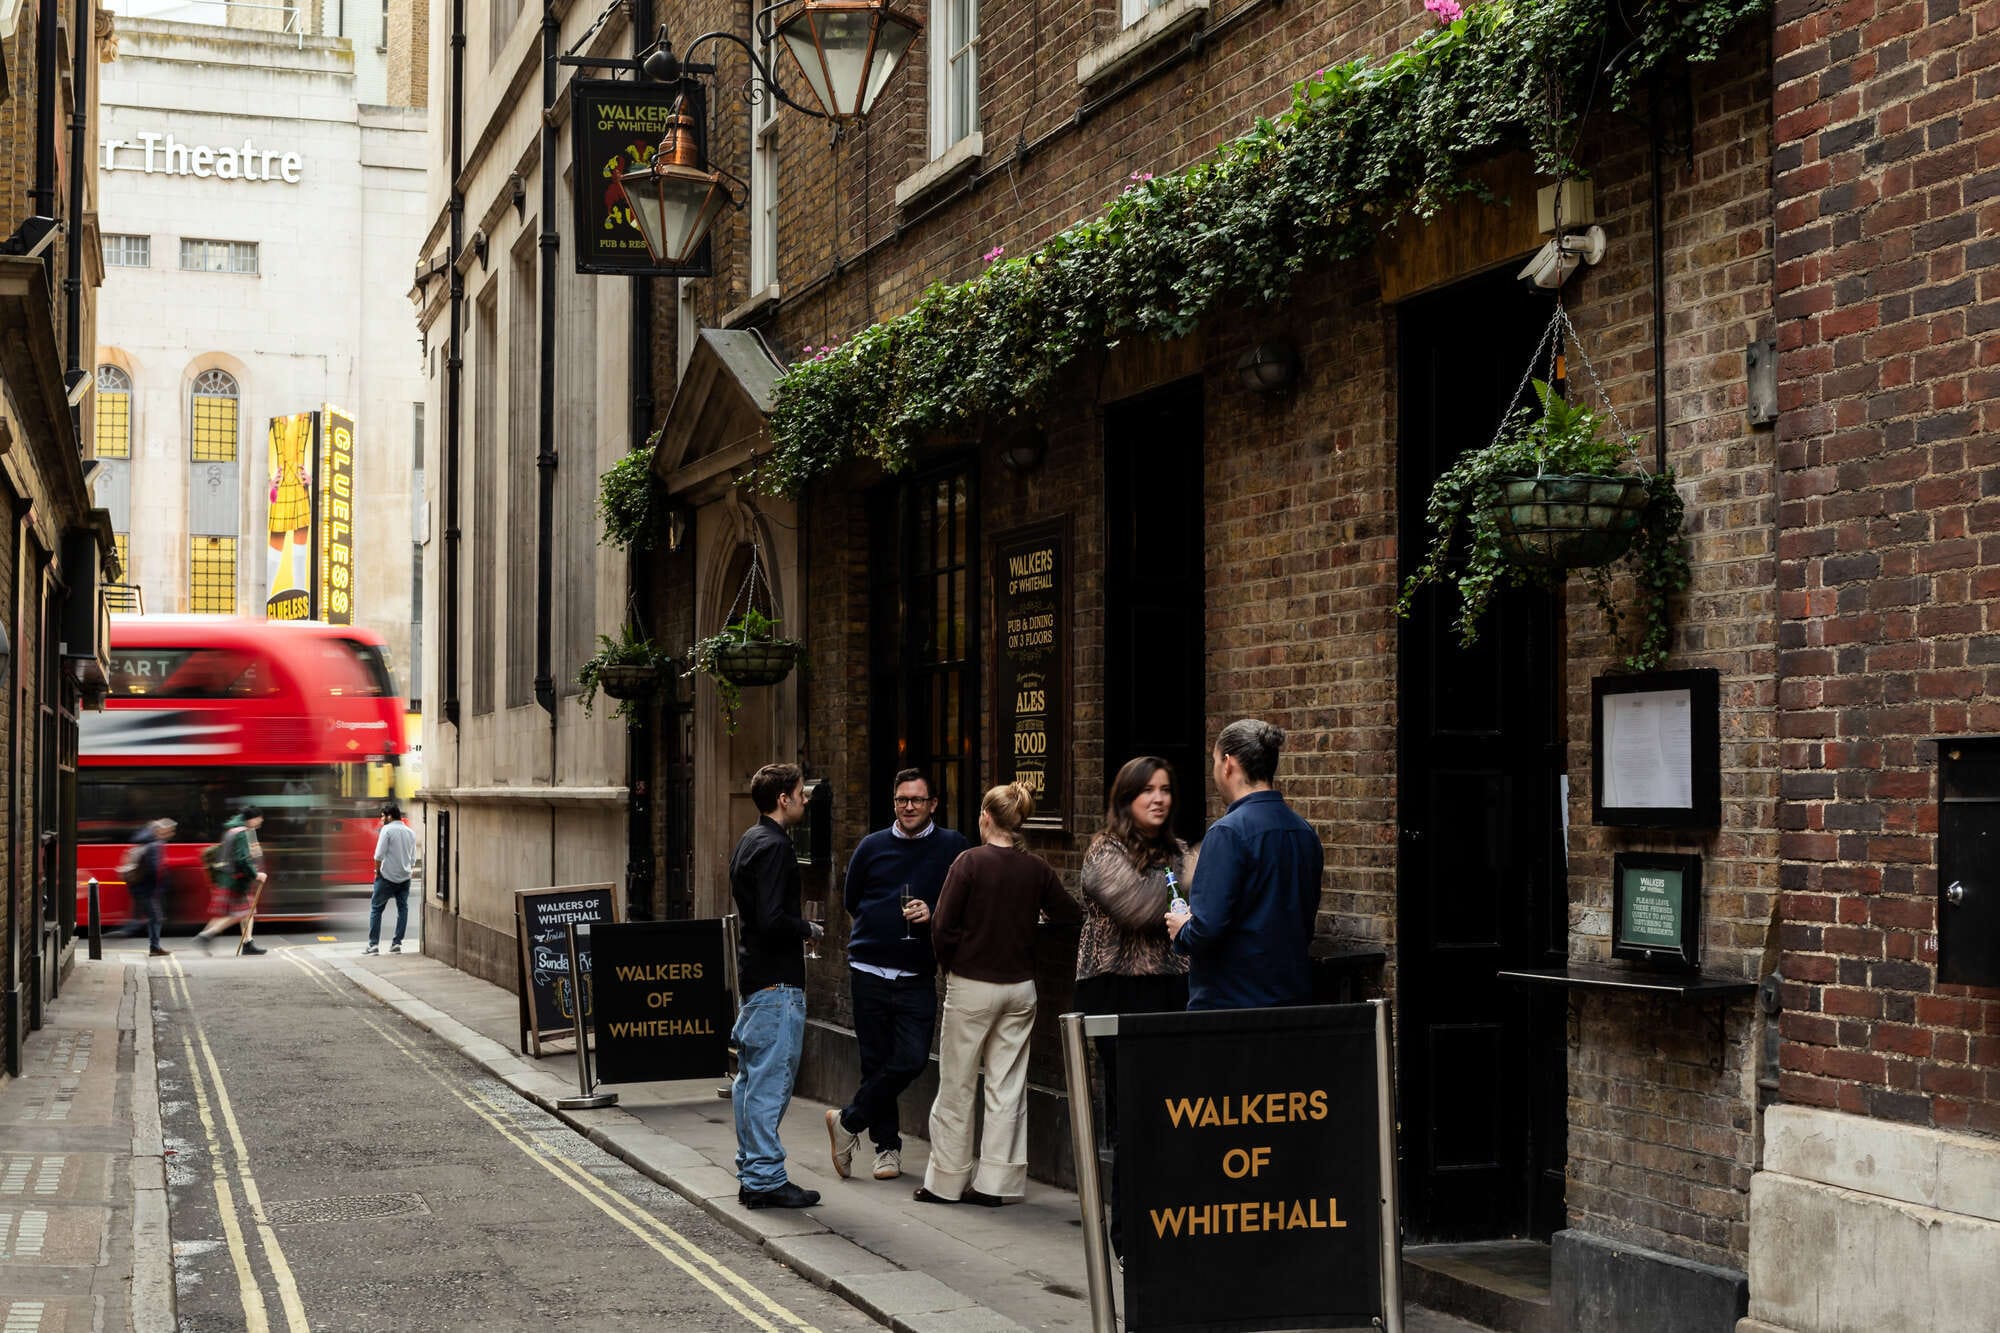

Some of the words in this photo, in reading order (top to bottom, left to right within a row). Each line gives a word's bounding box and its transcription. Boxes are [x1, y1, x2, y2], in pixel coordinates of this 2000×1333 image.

[598, 104, 669, 122] WALKER
[598, 120, 614, 131] OF
[136, 131, 303, 184] Theatre
[600, 239, 617, 248] PUB
[619, 239, 627, 248] &
[331, 426, 351, 614] CLUELESS
[1009, 548, 1053, 577] WALKERS
[1009, 580, 1018, 595] OF
[1019, 574, 1053, 593] WHITEHALL
[267, 596, 309, 620] CLUELESS
[1008, 619, 1021, 633] PUB
[1022, 618, 1028, 631] &
[1029, 614, 1053, 630] DINING
[1008, 635, 1019, 648] ON
[1020, 634, 1025, 647] 3
[1026, 629, 1053, 646] FLOORS
[1016, 690, 1045, 712] ALES
[1014, 732, 1047, 754] FOOD
[1640, 878, 1665, 887] WALKERS
[537, 900, 584, 912] WALKERS
[585, 899, 600, 909] OF
[538, 911, 601, 925] WHITEHALL
[538, 952, 569, 971] Sunda
[616, 963, 704, 982] WALKERS
[647, 992, 674, 1008] OF
[608, 1018, 715, 1039] WHITEHALL
[1164, 1089, 1329, 1129] WALKERS
[1222, 1146, 1272, 1179] OF
[1149, 1197, 1348, 1240] WHITEHALL
